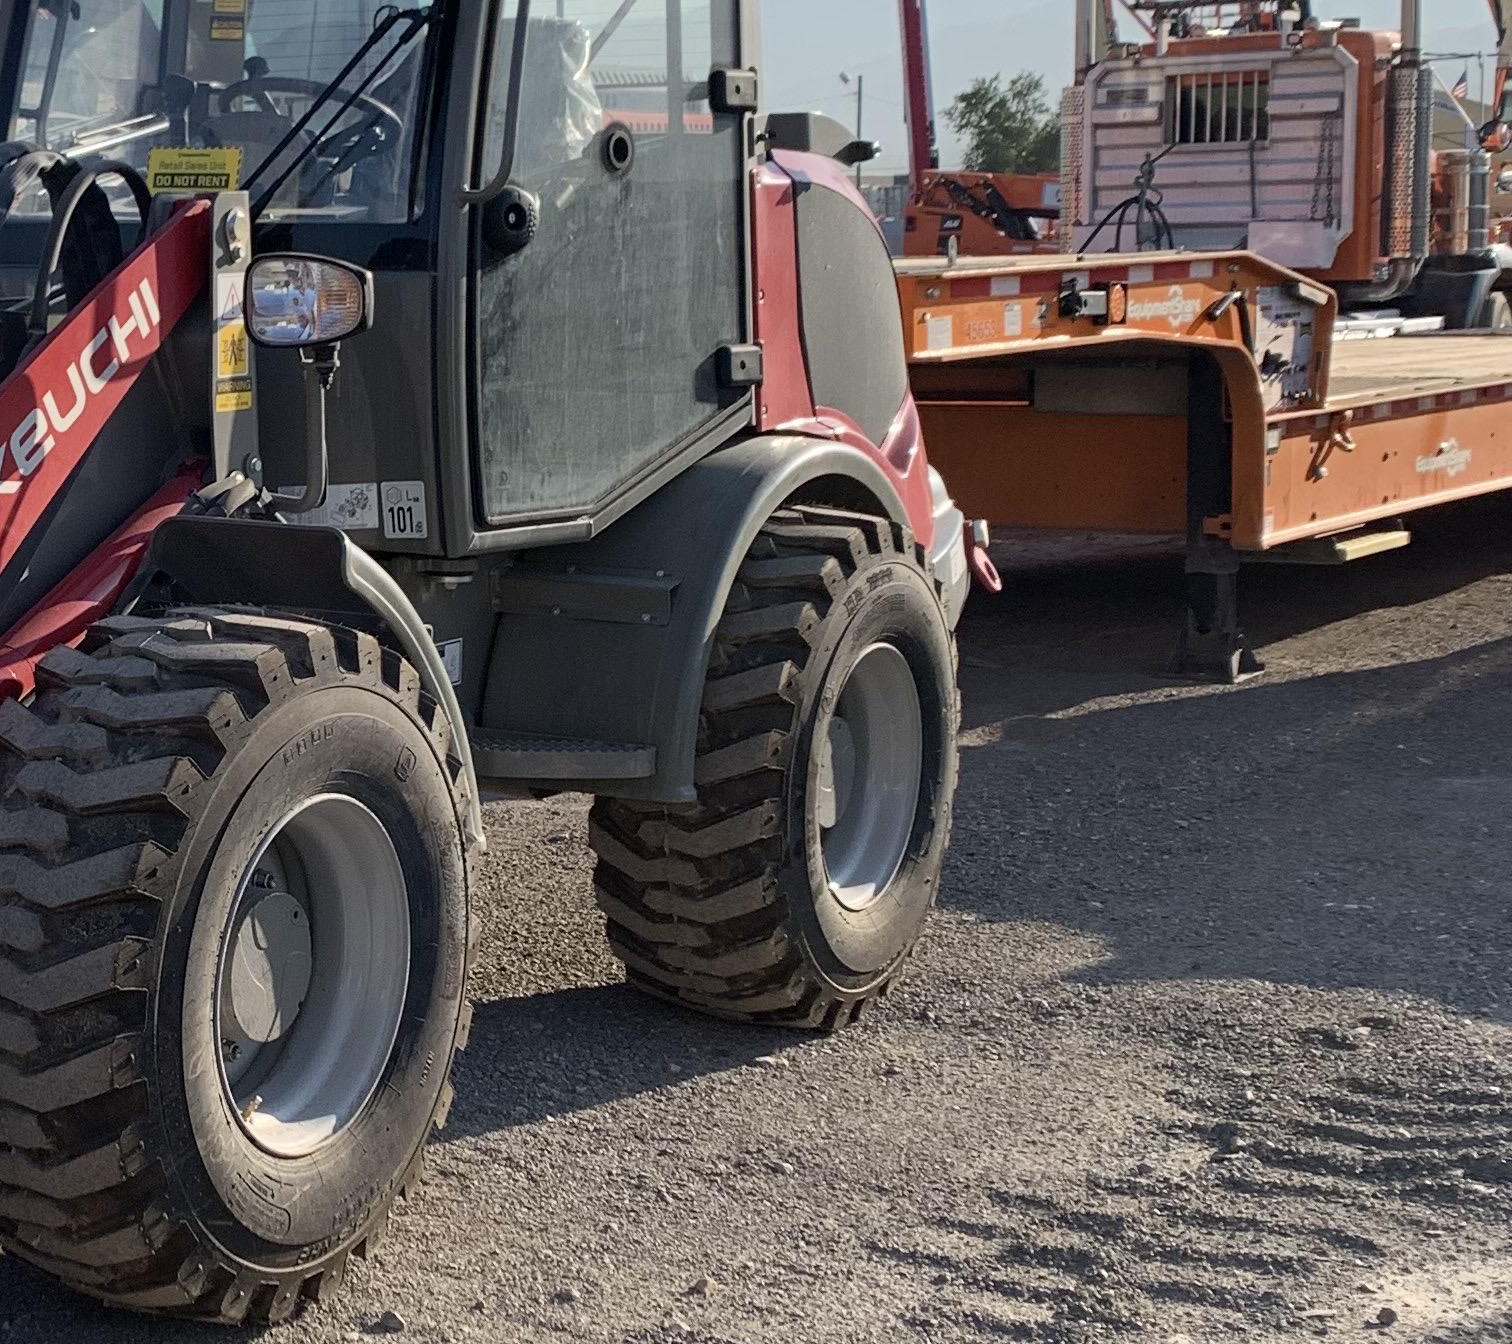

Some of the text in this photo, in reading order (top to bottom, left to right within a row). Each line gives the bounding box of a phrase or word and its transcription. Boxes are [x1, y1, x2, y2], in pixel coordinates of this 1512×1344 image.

[156, 174, 228, 187] DO NOT RENT
[388, 505, 414, 534] 101
